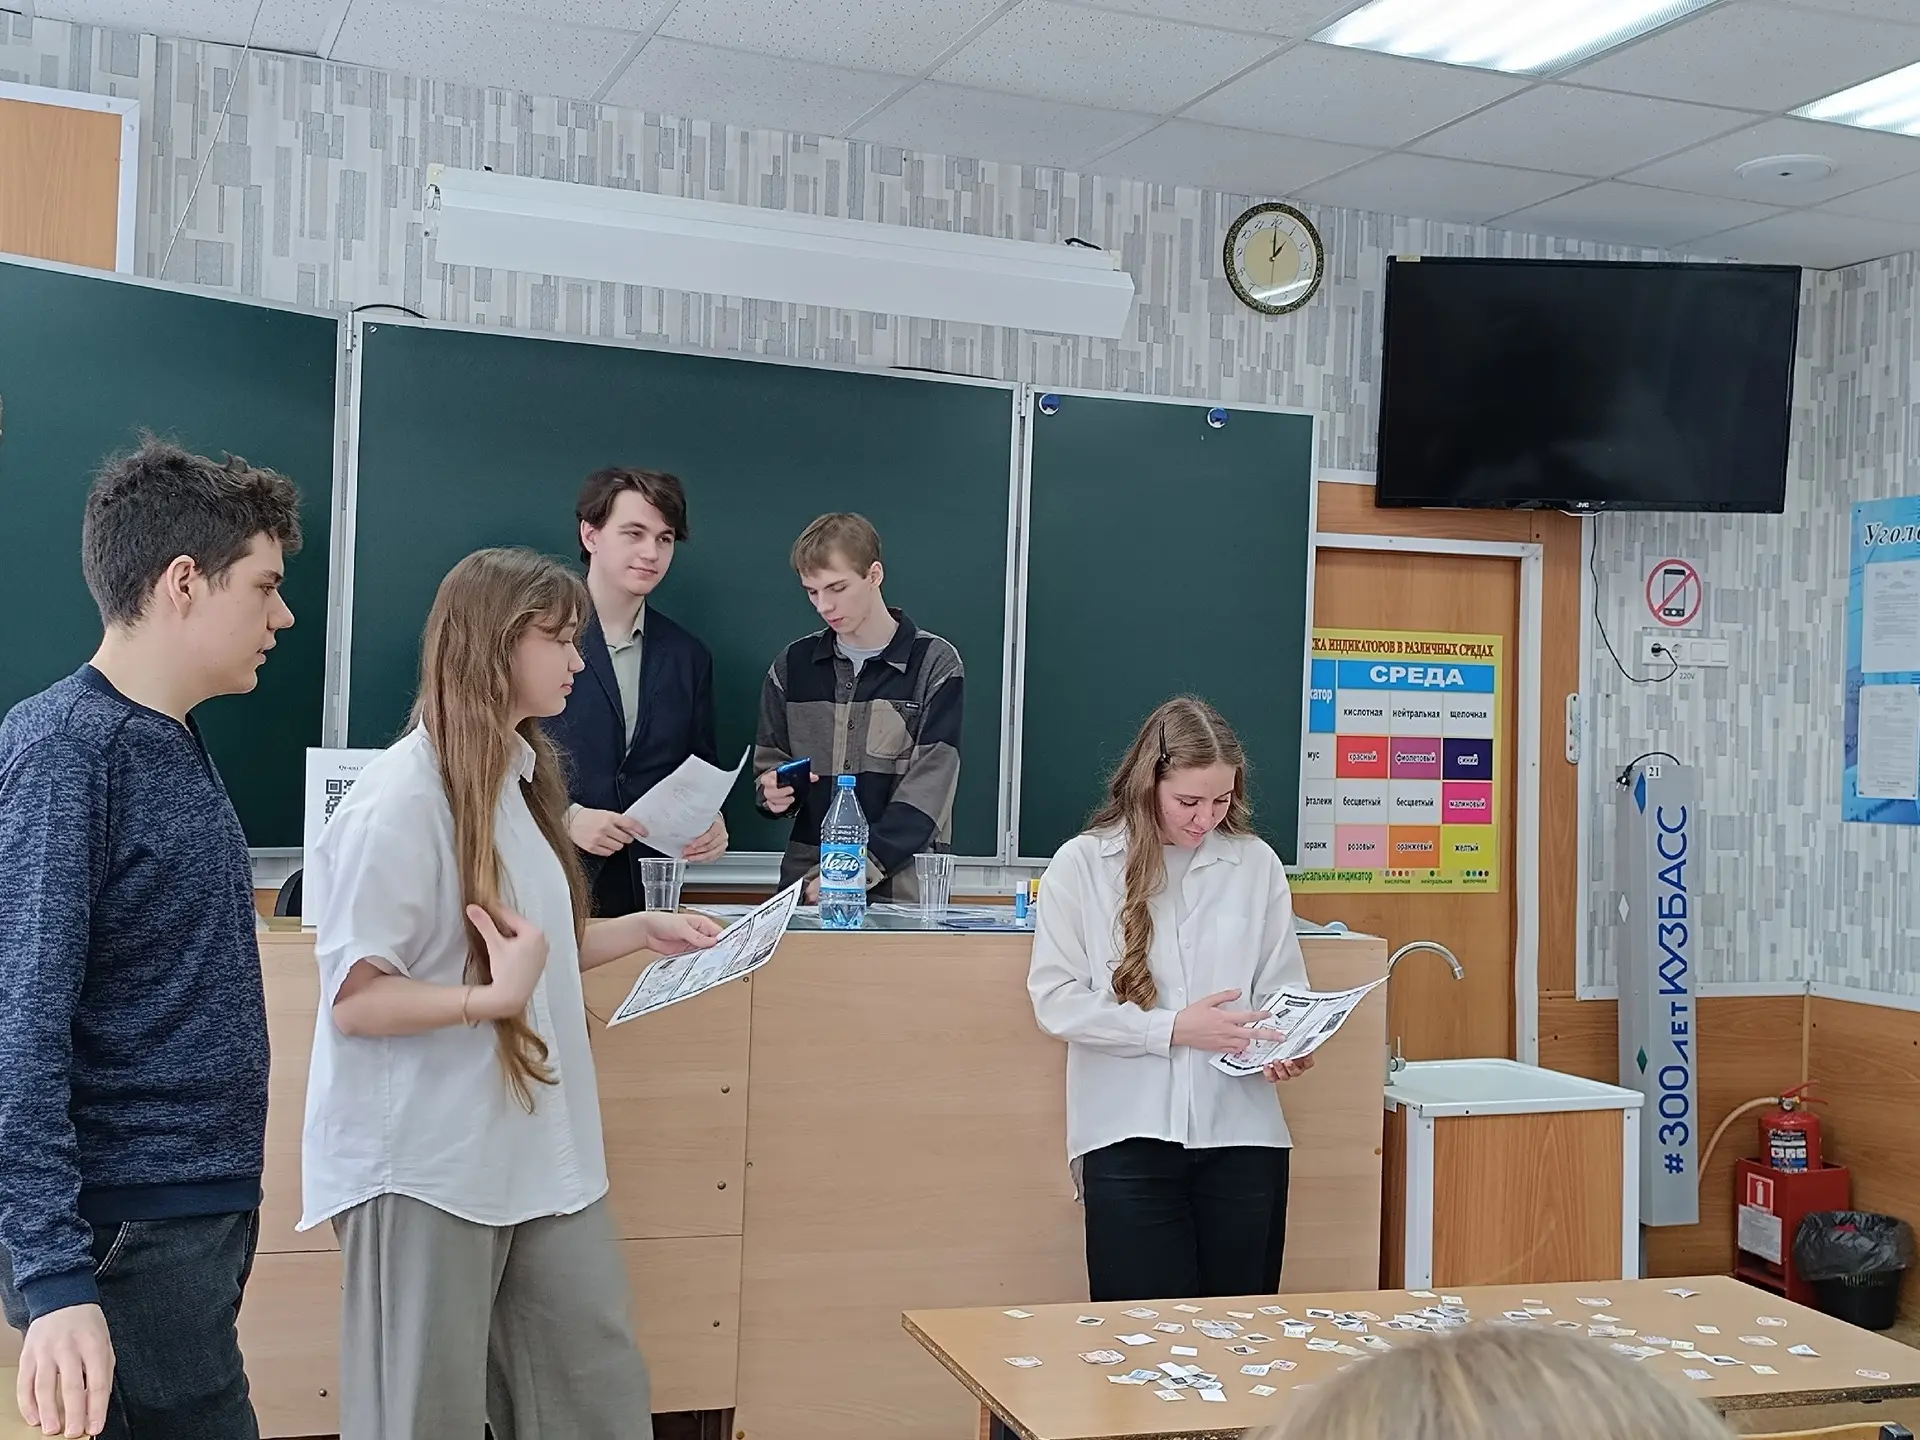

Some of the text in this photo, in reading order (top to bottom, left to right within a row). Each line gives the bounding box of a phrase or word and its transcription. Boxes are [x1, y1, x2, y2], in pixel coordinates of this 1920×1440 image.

[1328, 638, 1396, 655] ИНДИКАТОРОВ
[1396, 640, 1403, 653] В
[1404, 641, 1458, 656] РАЗЛИЧНЫХ
[1459, 643, 1494, 659] СРЕДАХ
[1369, 665, 1465, 688] СРЕДА
[1343, 707, 1383, 717] кислотная
[1392, 708, 1440, 719] нейтральная
[1450, 710, 1487, 719] щелочная
[1348, 751, 1377, 763] красный
[1395, 752, 1436, 764] фиолетовый
[1458, 753, 1478, 765] синий
[1648, 766, 1660, 777] 21
[1342, 796, 1381, 807] бесцветный
[1396, 797, 1434, 807] бесцветный
[1449, 798, 1486, 809] малиновый
[1347, 841, 1375, 851] розовый
[1396, 841, 1433, 852] оранжевый
[1455, 842, 1479, 852] желтый
[1337, 871, 1373, 884] индикатор
